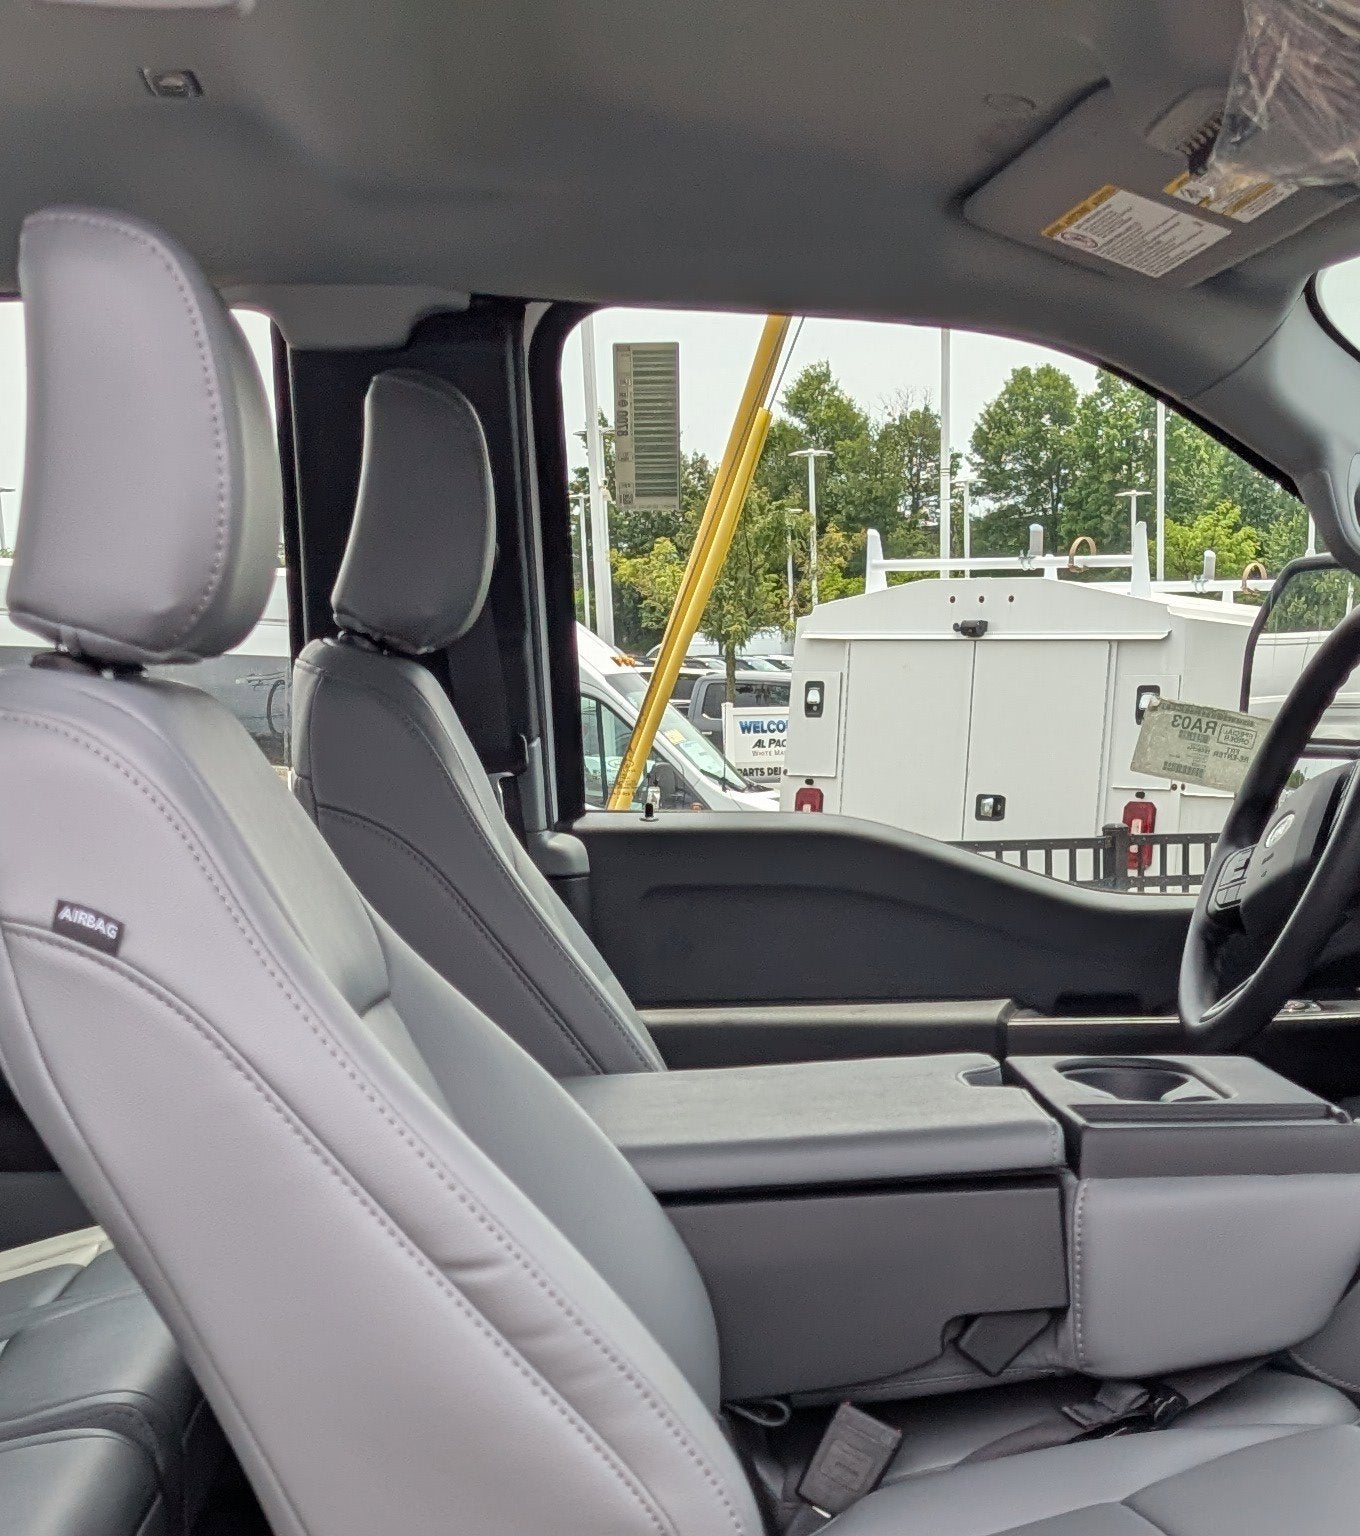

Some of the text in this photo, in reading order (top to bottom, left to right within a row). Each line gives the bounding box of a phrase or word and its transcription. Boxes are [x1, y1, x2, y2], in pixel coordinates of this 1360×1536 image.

[752, 739, 766, 748] AL
[767, 766, 782, 776] DE
[58, 906, 119, 940] AIRBAG
